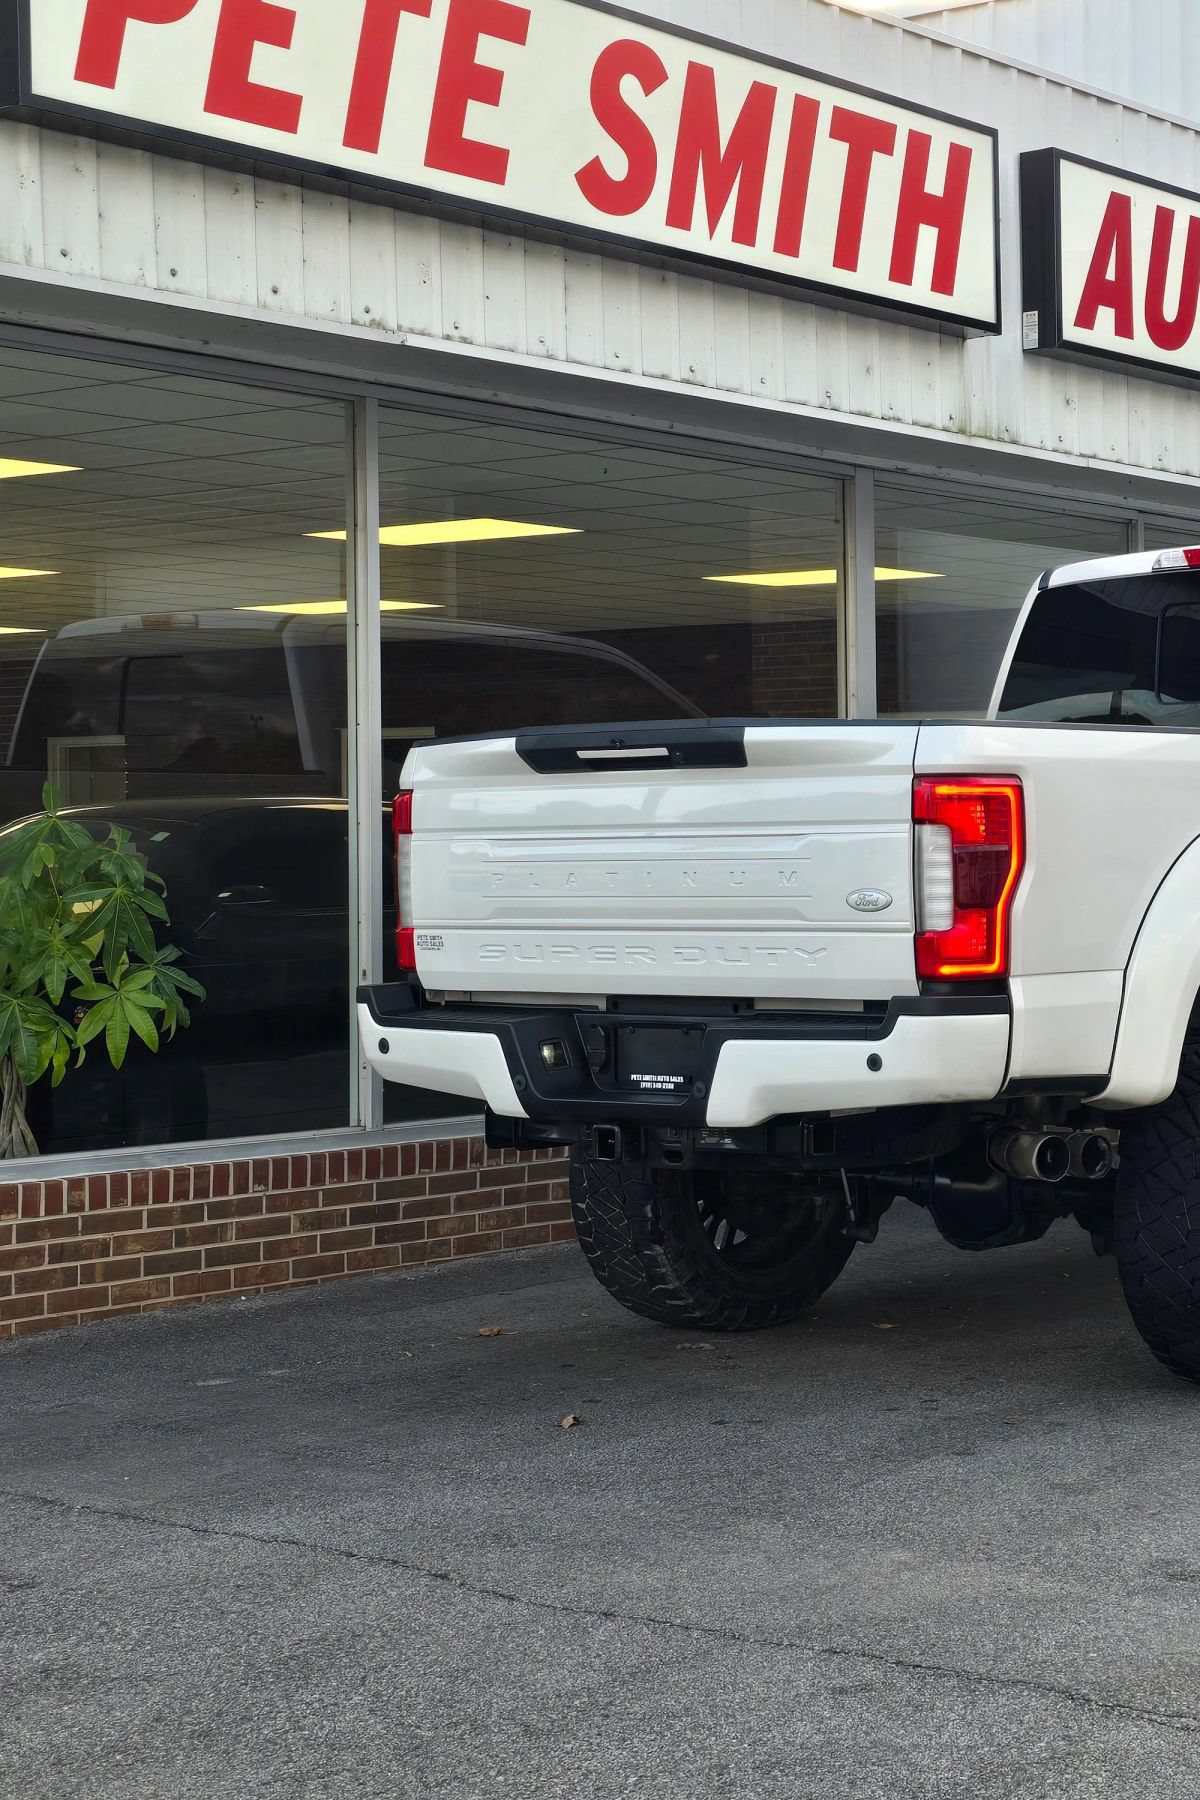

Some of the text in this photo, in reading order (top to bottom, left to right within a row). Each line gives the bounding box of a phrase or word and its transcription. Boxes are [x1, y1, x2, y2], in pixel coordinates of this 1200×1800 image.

[575, 39, 972, 296] SMITH
[491, 870, 798, 888] PLATINUM
[479, 944, 828, 967] SUPER DUTY
